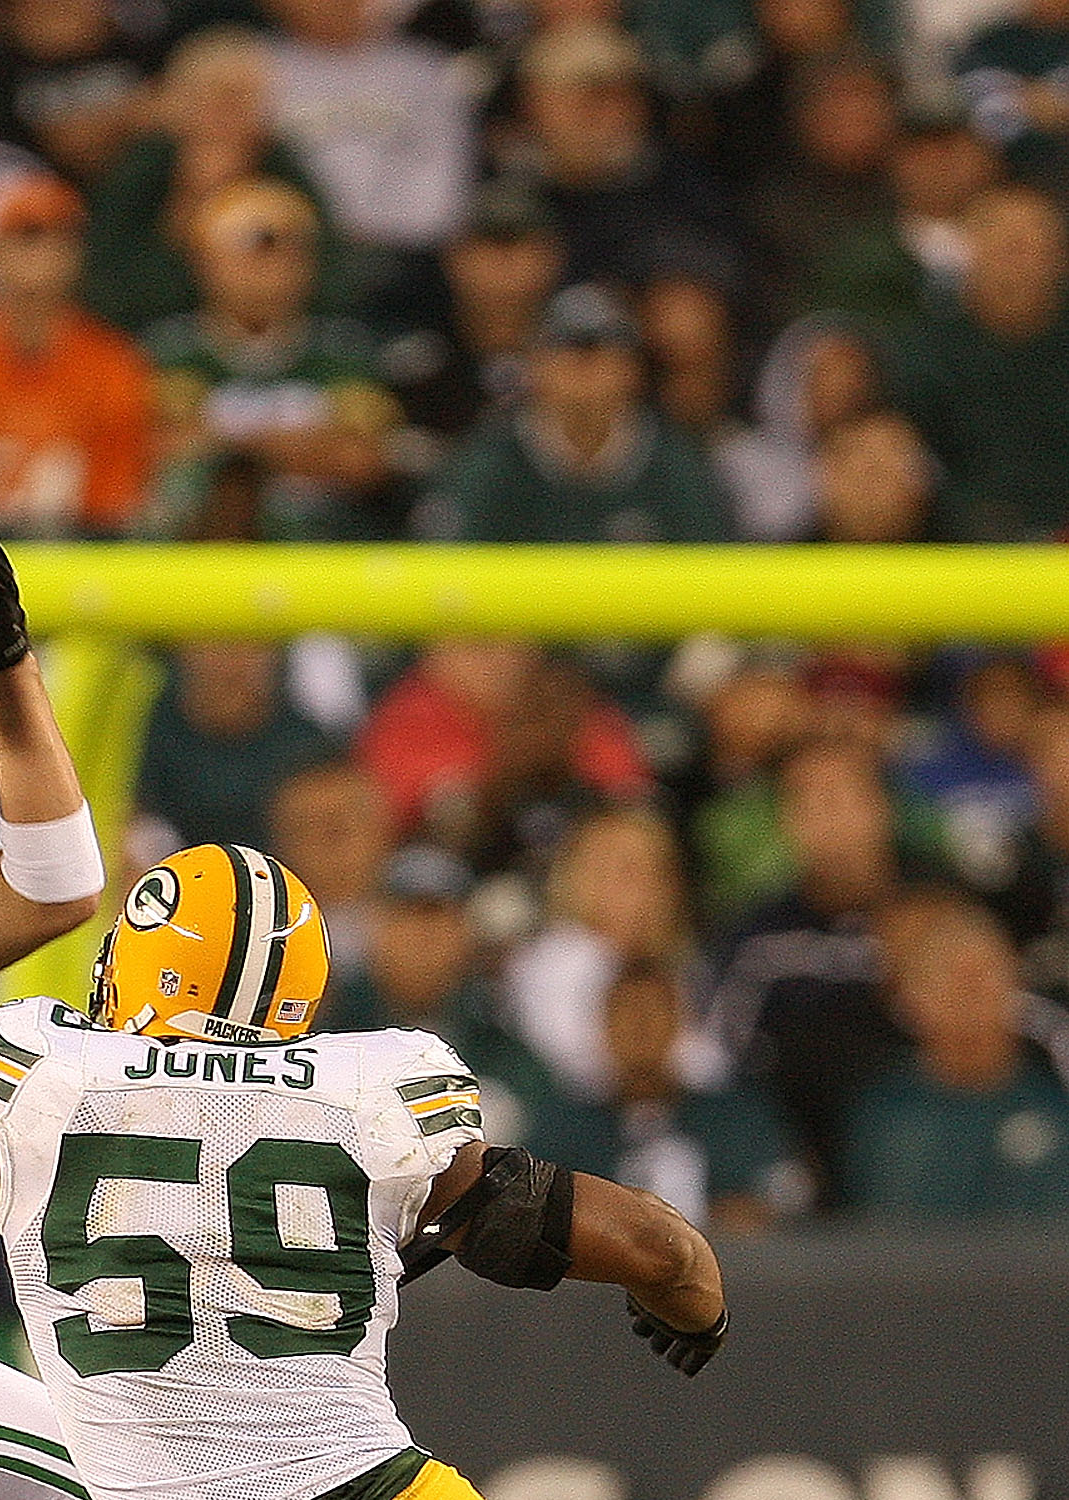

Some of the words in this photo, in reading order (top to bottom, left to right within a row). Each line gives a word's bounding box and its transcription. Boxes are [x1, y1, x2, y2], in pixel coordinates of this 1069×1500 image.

[204, 1018, 262, 1043] PACKERS
[124, 1046, 319, 1090] JONES
[41, 1133, 376, 1378] 59
